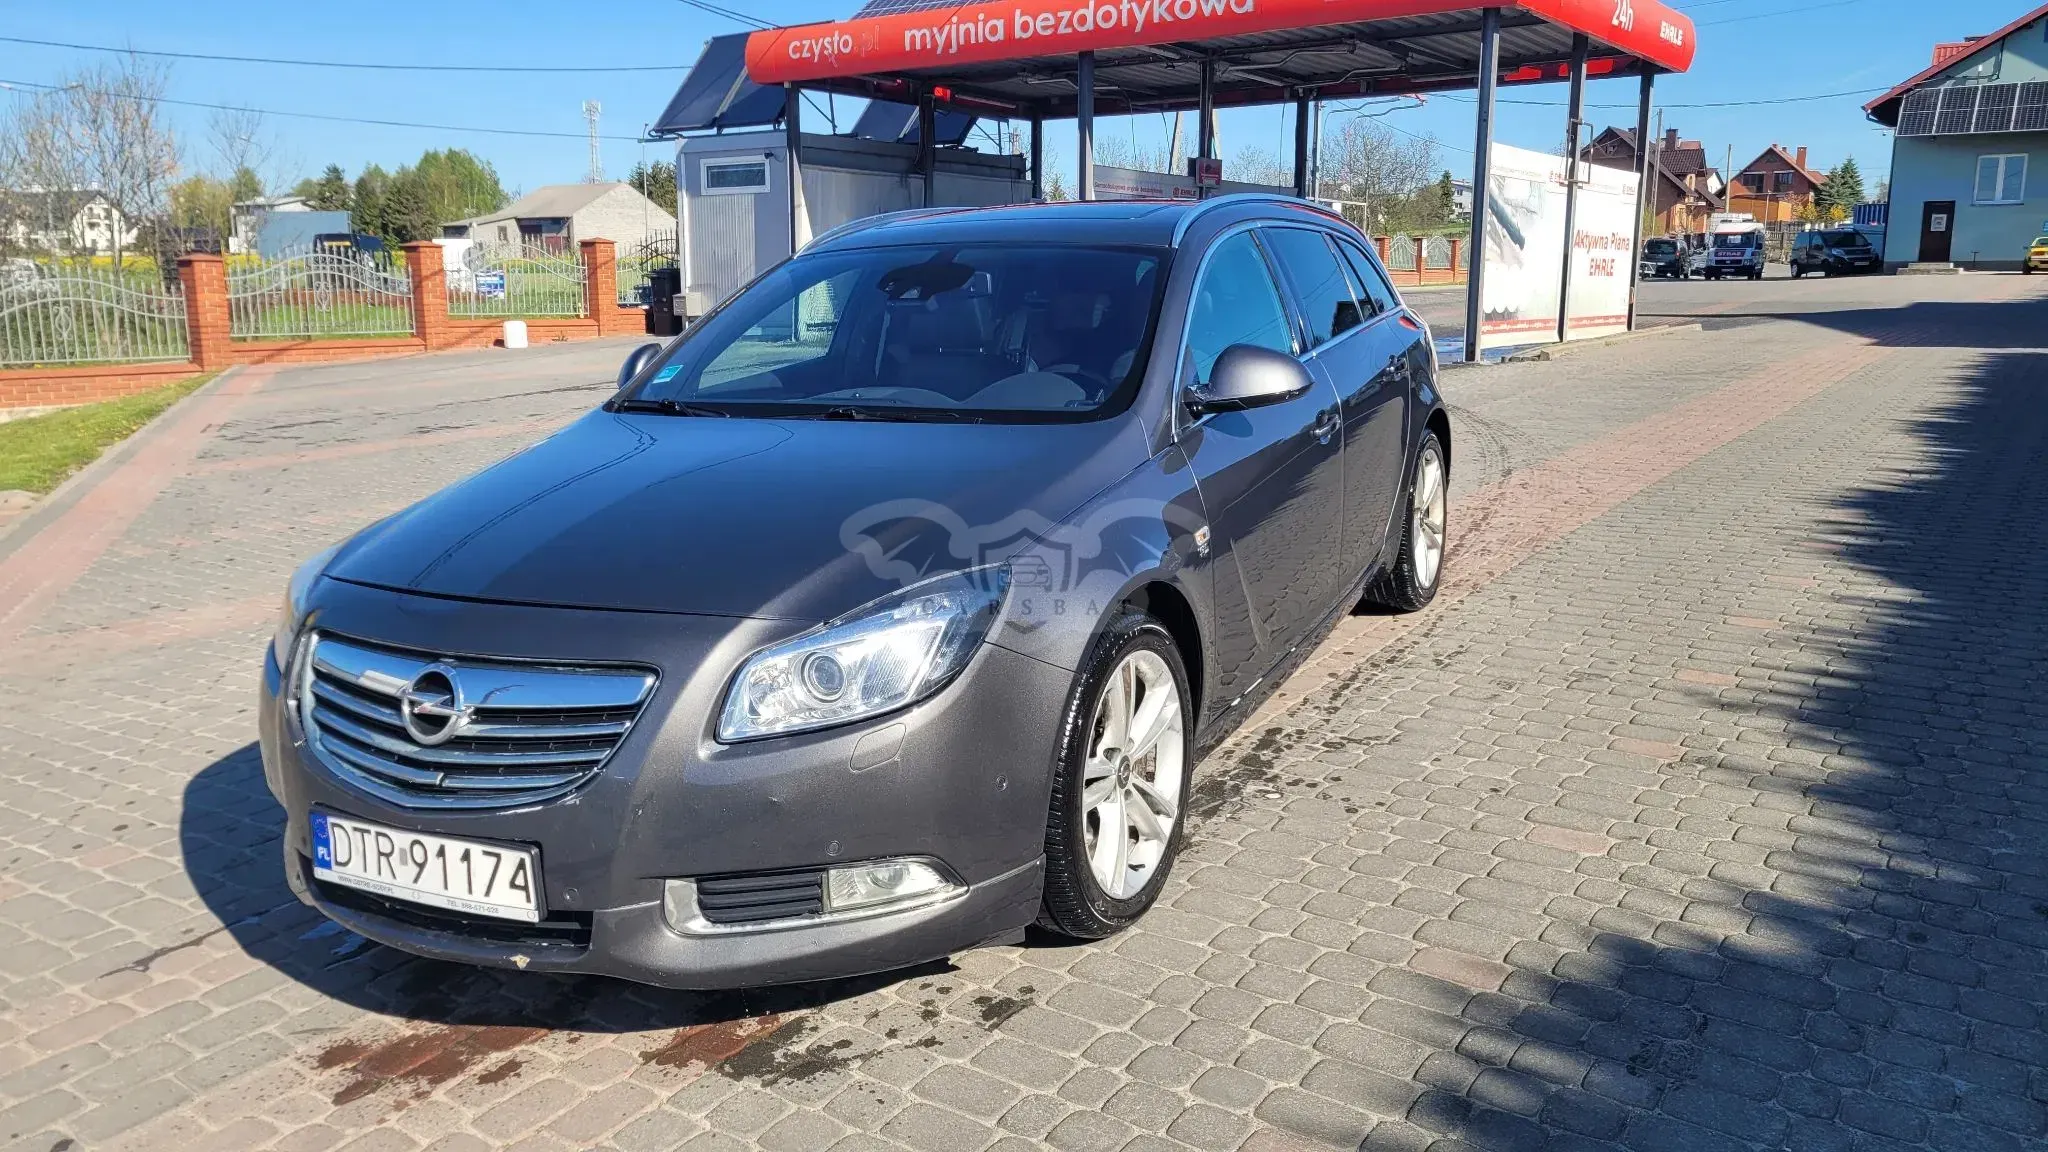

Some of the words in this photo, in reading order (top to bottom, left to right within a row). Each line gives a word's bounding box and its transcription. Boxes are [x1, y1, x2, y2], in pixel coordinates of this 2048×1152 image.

[904, 14, 1005, 54] myjnia
[1013, 0, 1254, 40] bezdotykowa
[1611, 0, 1634, 32] 24h
[1660, 20, 1684, 47] EHRLE
[1574, 229, 1609, 254] Aktywna
[1610, 231, 1630, 251] Piana
[1589, 258, 1616, 277] EHRLE
[317, 846, 331, 860] PL
[331, 822, 397, 880] DTR
[409, 838, 531, 904] 91174
